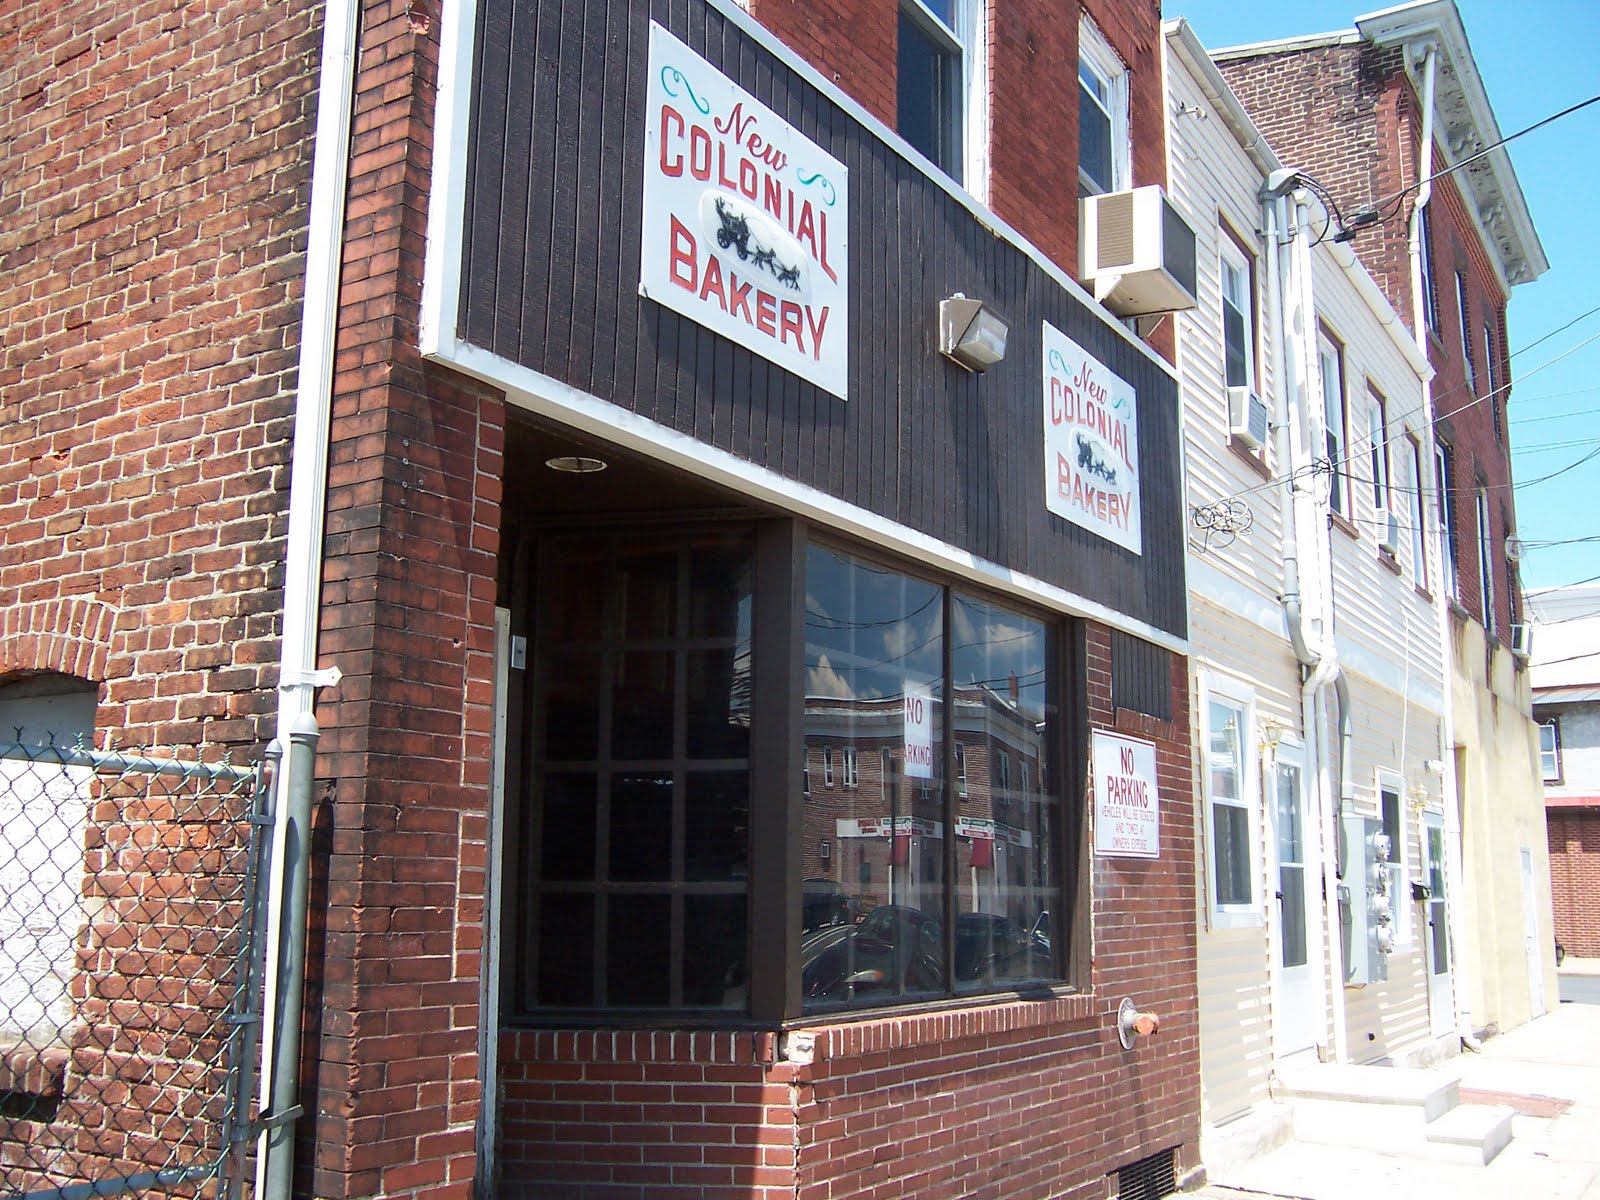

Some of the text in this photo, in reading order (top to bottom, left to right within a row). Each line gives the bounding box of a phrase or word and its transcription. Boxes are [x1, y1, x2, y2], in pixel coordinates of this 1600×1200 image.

[713, 102, 788, 172] New
[659, 104, 838, 285] COLONIAL
[670, 213, 829, 361] BAKERY
[1074, 361, 1107, 405] New
[1051, 376, 1134, 475] COLONIAL
[1057, 451, 1132, 532] BAKERY
[906, 697, 923, 725] NO
[1107, 775, 1148, 808] PARKING
[1120, 746, 1135, 776] NO
